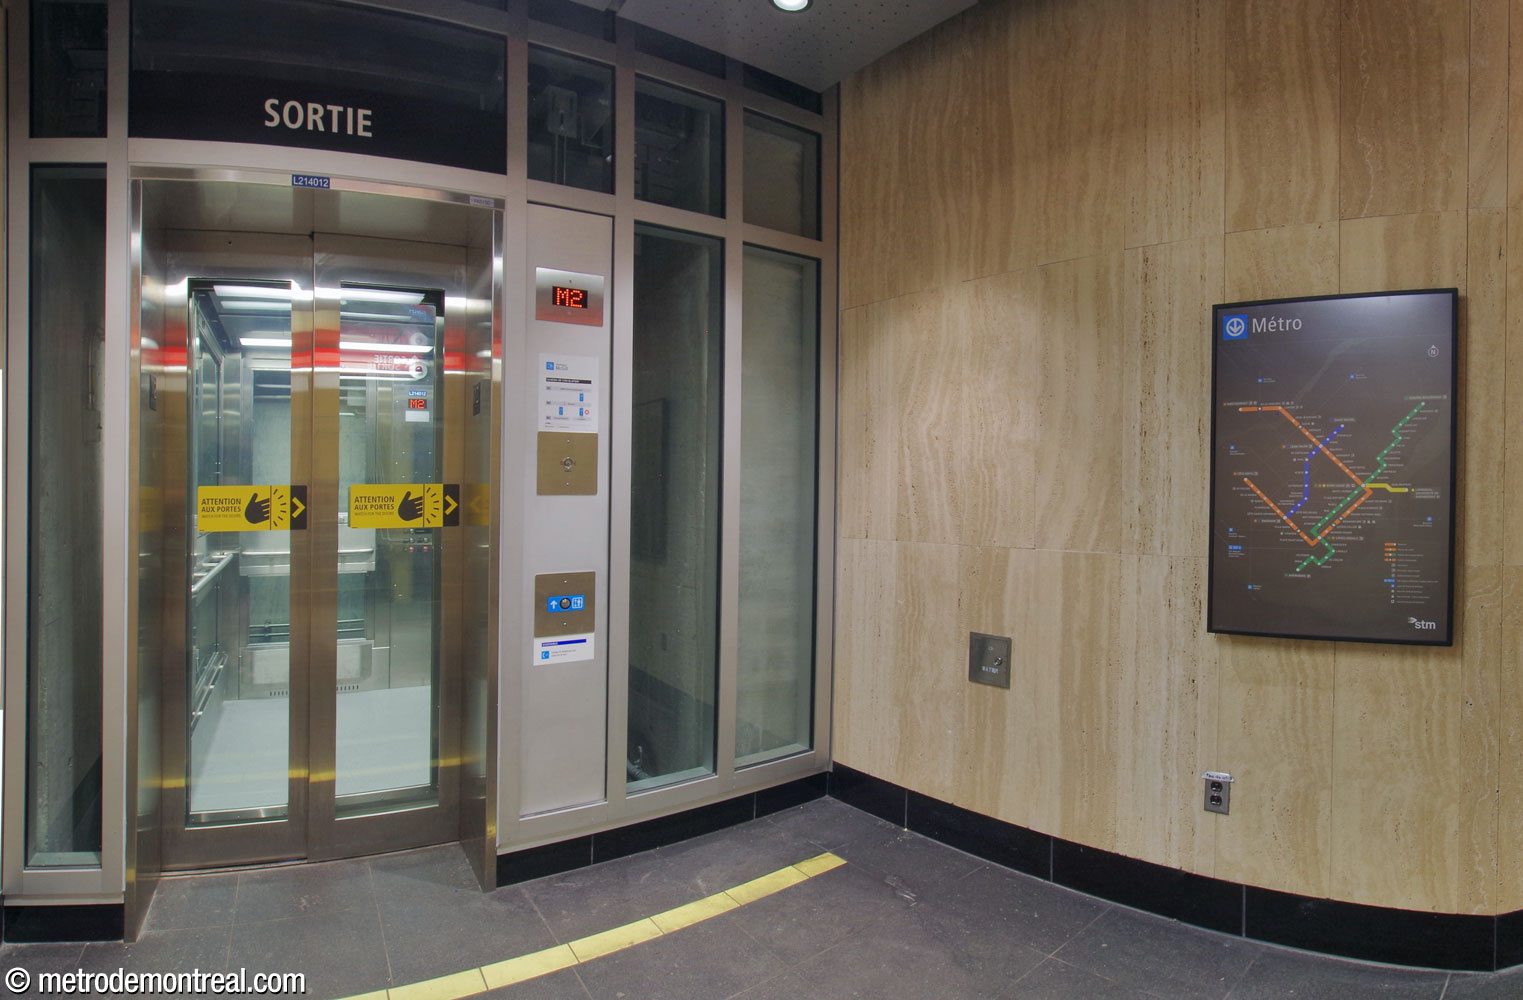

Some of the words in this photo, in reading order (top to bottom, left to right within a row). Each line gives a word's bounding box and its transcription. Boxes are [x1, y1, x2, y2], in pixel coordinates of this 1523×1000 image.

[264, 98, 373, 138] SORTIE
[293, 176, 329, 188] L214012
[556, 287, 583, 308] M2
[1251, 315, 1303, 333] Métro
[409, 399, 426, 409] M2
[216, 505, 242, 513] PORTES
[369, 503, 395, 511] PORTES
[1414, 619, 1436, 630] stm
